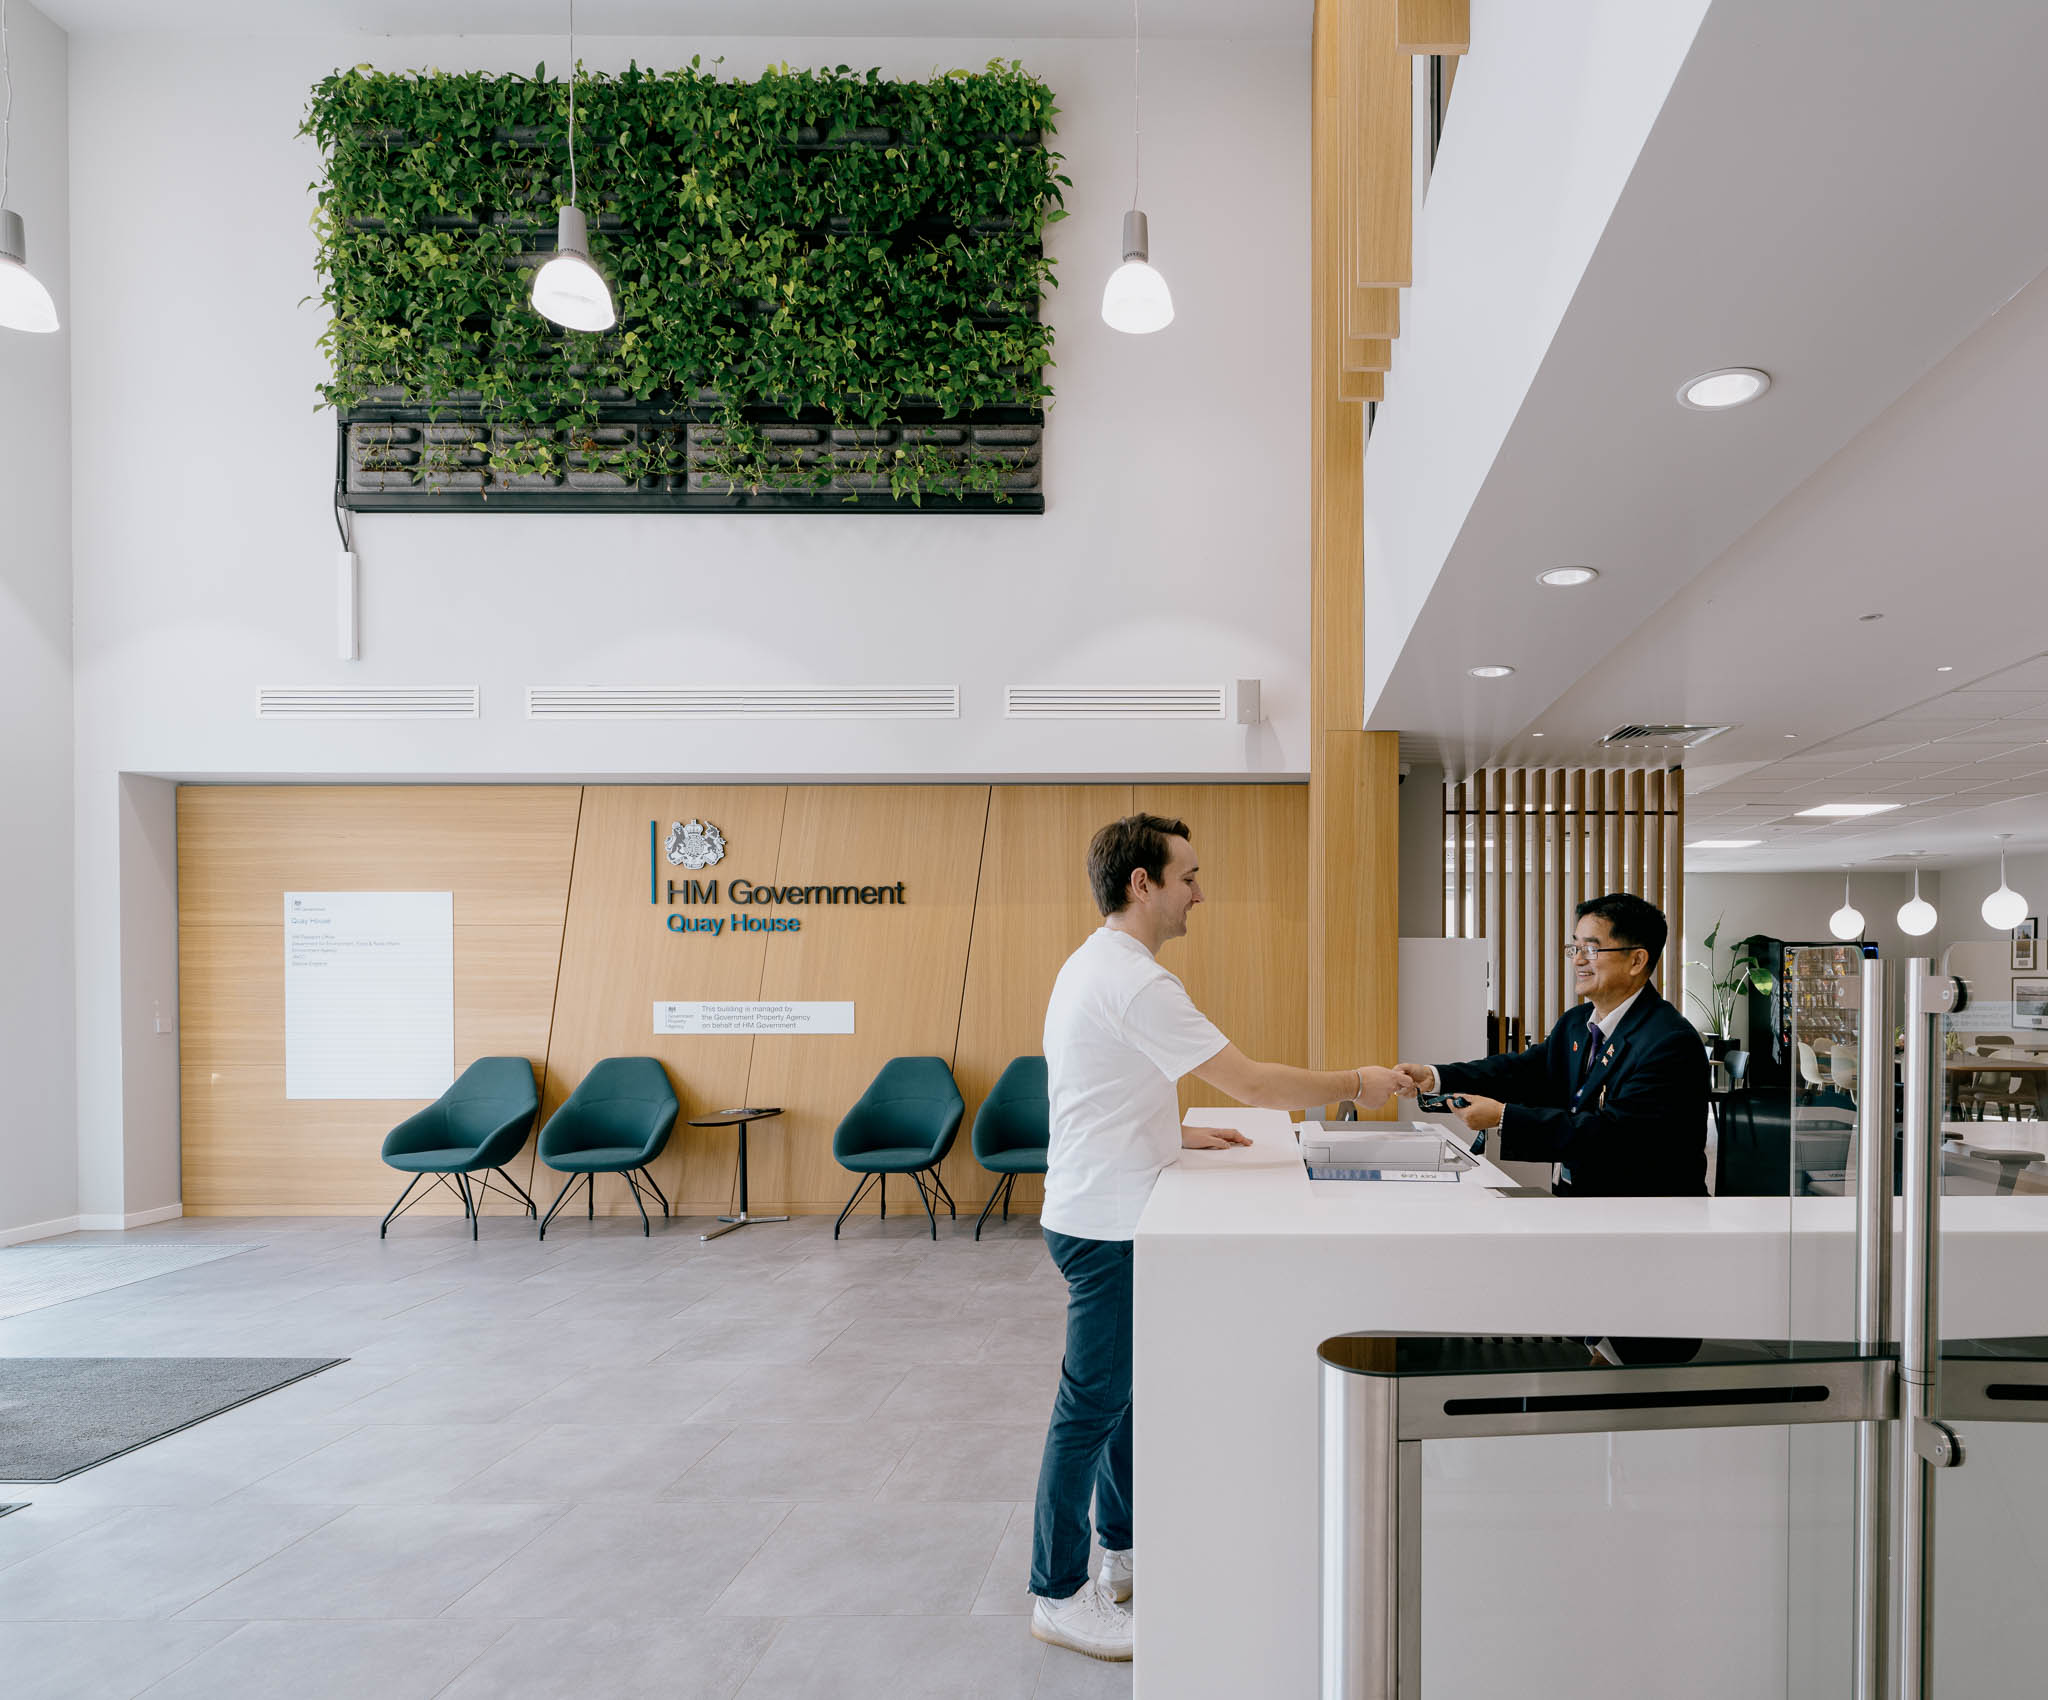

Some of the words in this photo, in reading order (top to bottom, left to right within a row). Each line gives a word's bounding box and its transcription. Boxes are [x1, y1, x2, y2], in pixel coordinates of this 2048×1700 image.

[667, 879, 719, 904] HM
[728, 879, 905, 905] Government
[667, 913, 724, 936] Quay
[730, 913, 801, 932] House
[717, 1005, 743, 1014] building
[752, 1005, 783, 1014] managed
[784, 1005, 793, 1014] by
[756, 1014, 784, 1022] Property
[786, 1014, 811, 1022] Agency
